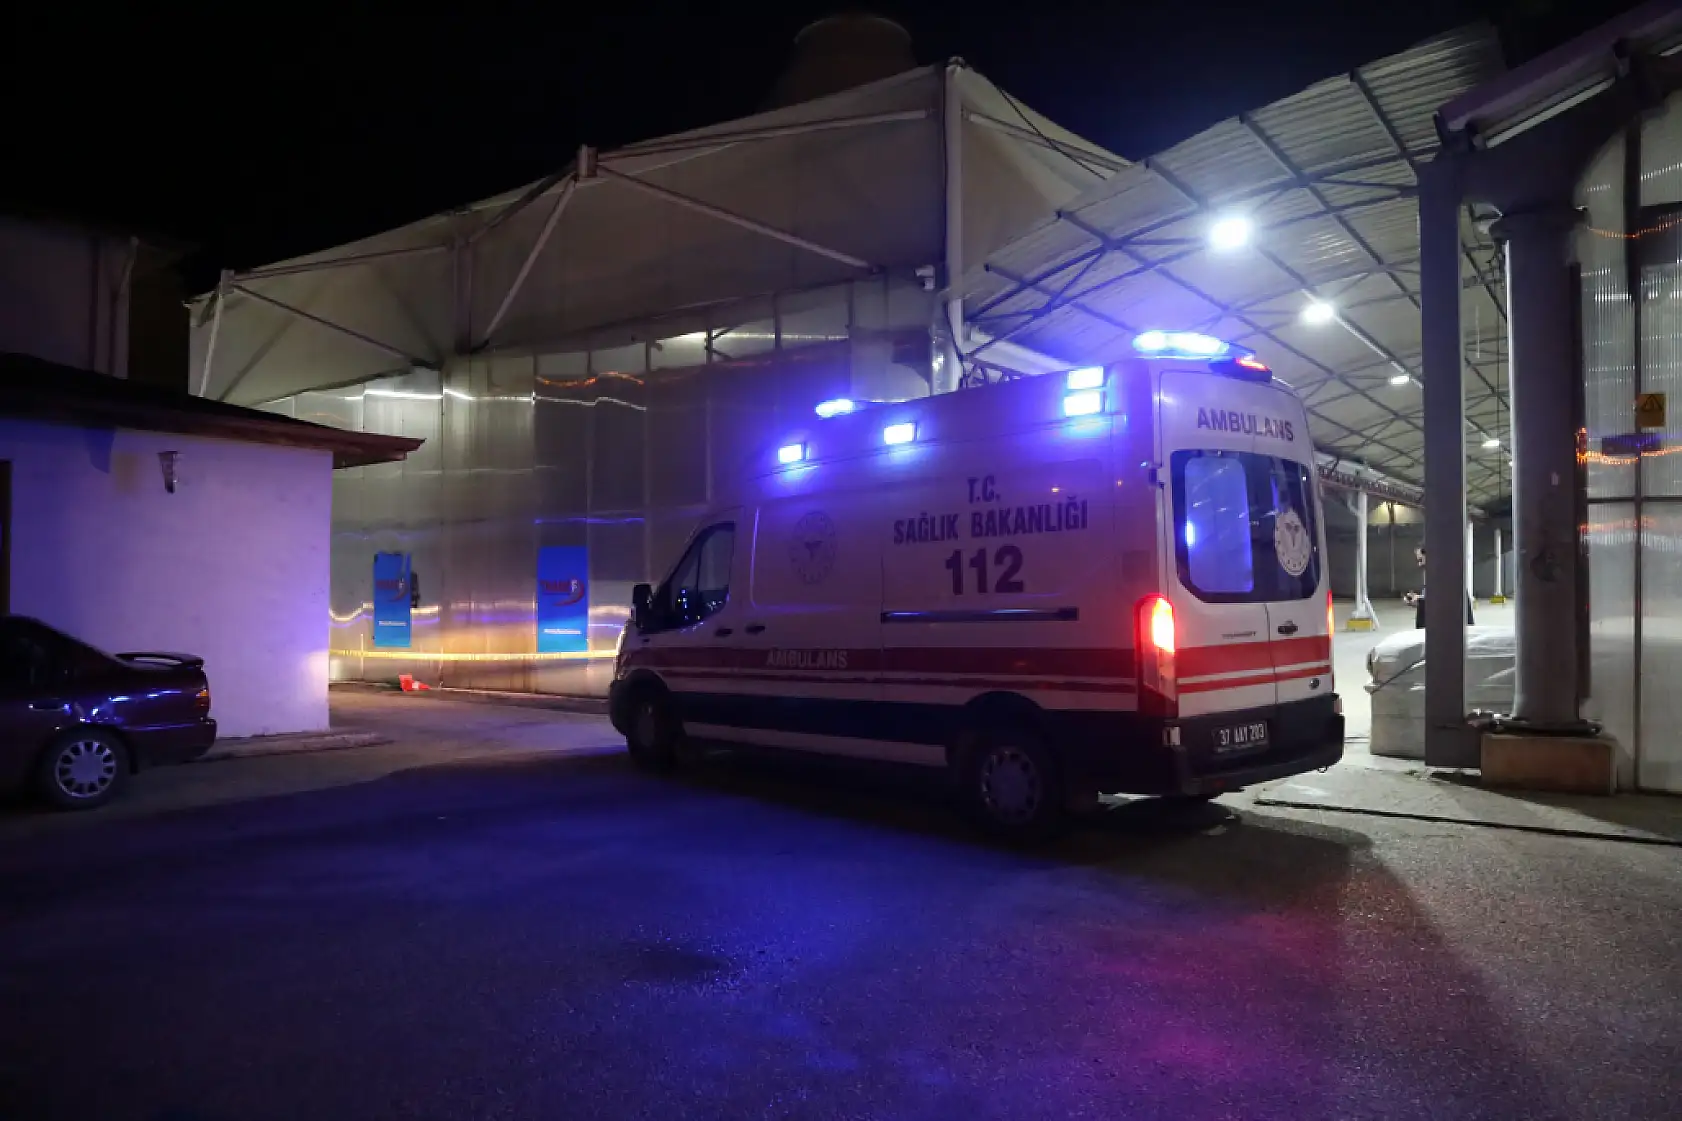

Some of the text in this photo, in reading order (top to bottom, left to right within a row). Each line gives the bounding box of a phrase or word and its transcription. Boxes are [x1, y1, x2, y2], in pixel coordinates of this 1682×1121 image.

[1197, 406, 1294, 442] AMBULANS
[967, 475, 1001, 504] T.C.
[893, 496, 1087, 544] SAĞLIK BAKANLIĞI
[945, 545, 1024, 596] 112
[766, 648, 848, 669] AMBULANS
